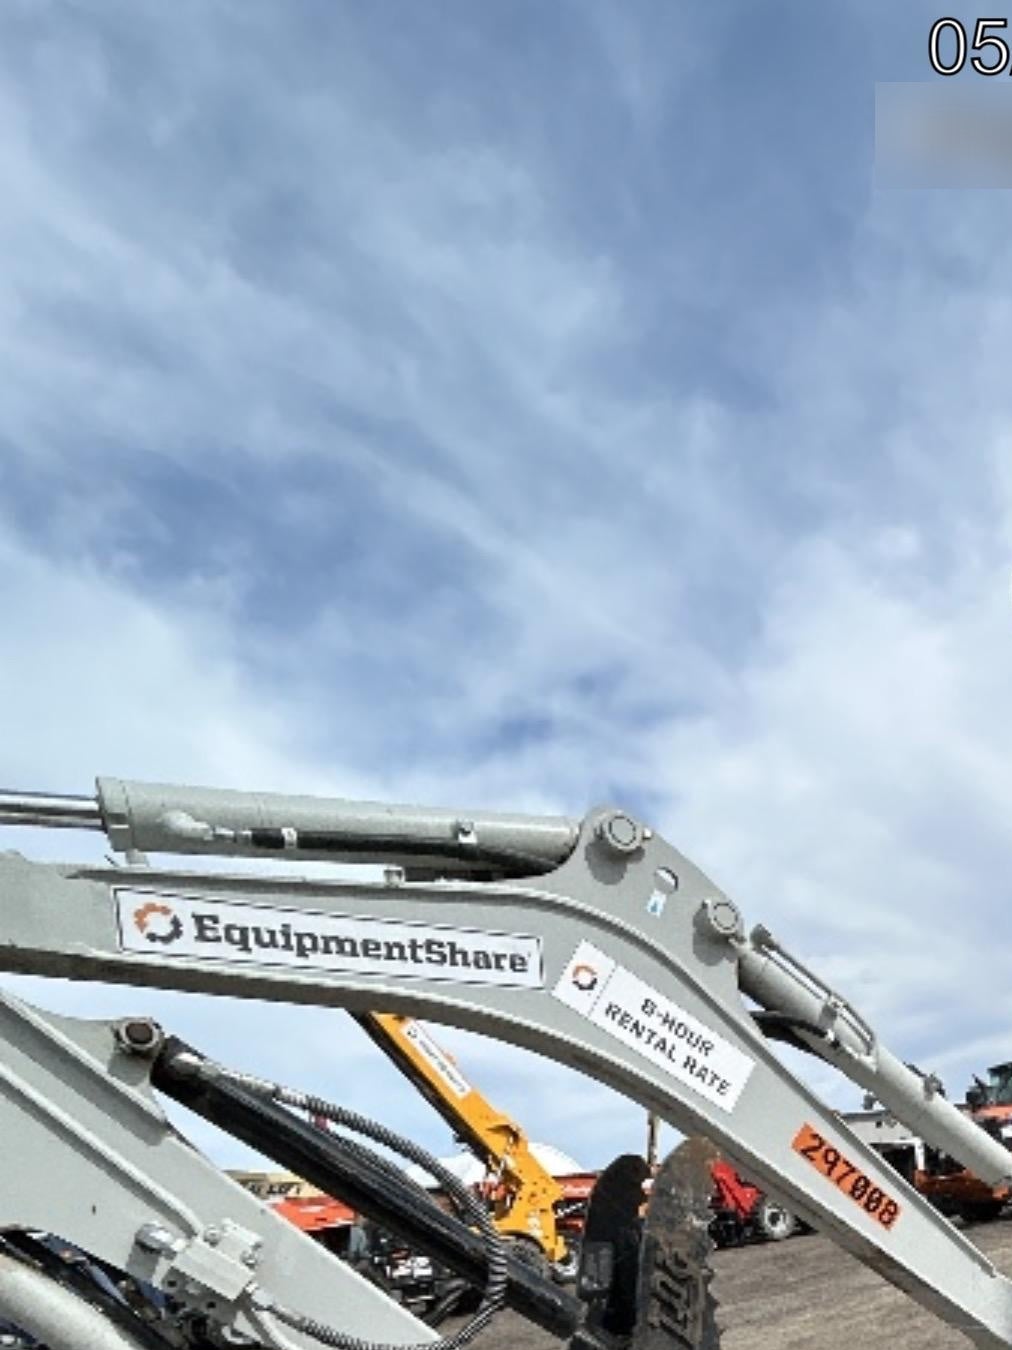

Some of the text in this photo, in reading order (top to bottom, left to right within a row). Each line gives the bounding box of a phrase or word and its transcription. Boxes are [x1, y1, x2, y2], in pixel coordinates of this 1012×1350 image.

[191, 911, 530, 974] EquipmentShare
[605, 1001, 733, 1097] RENTAL RATE
[640, 997, 715, 1057] 8-HOUR
